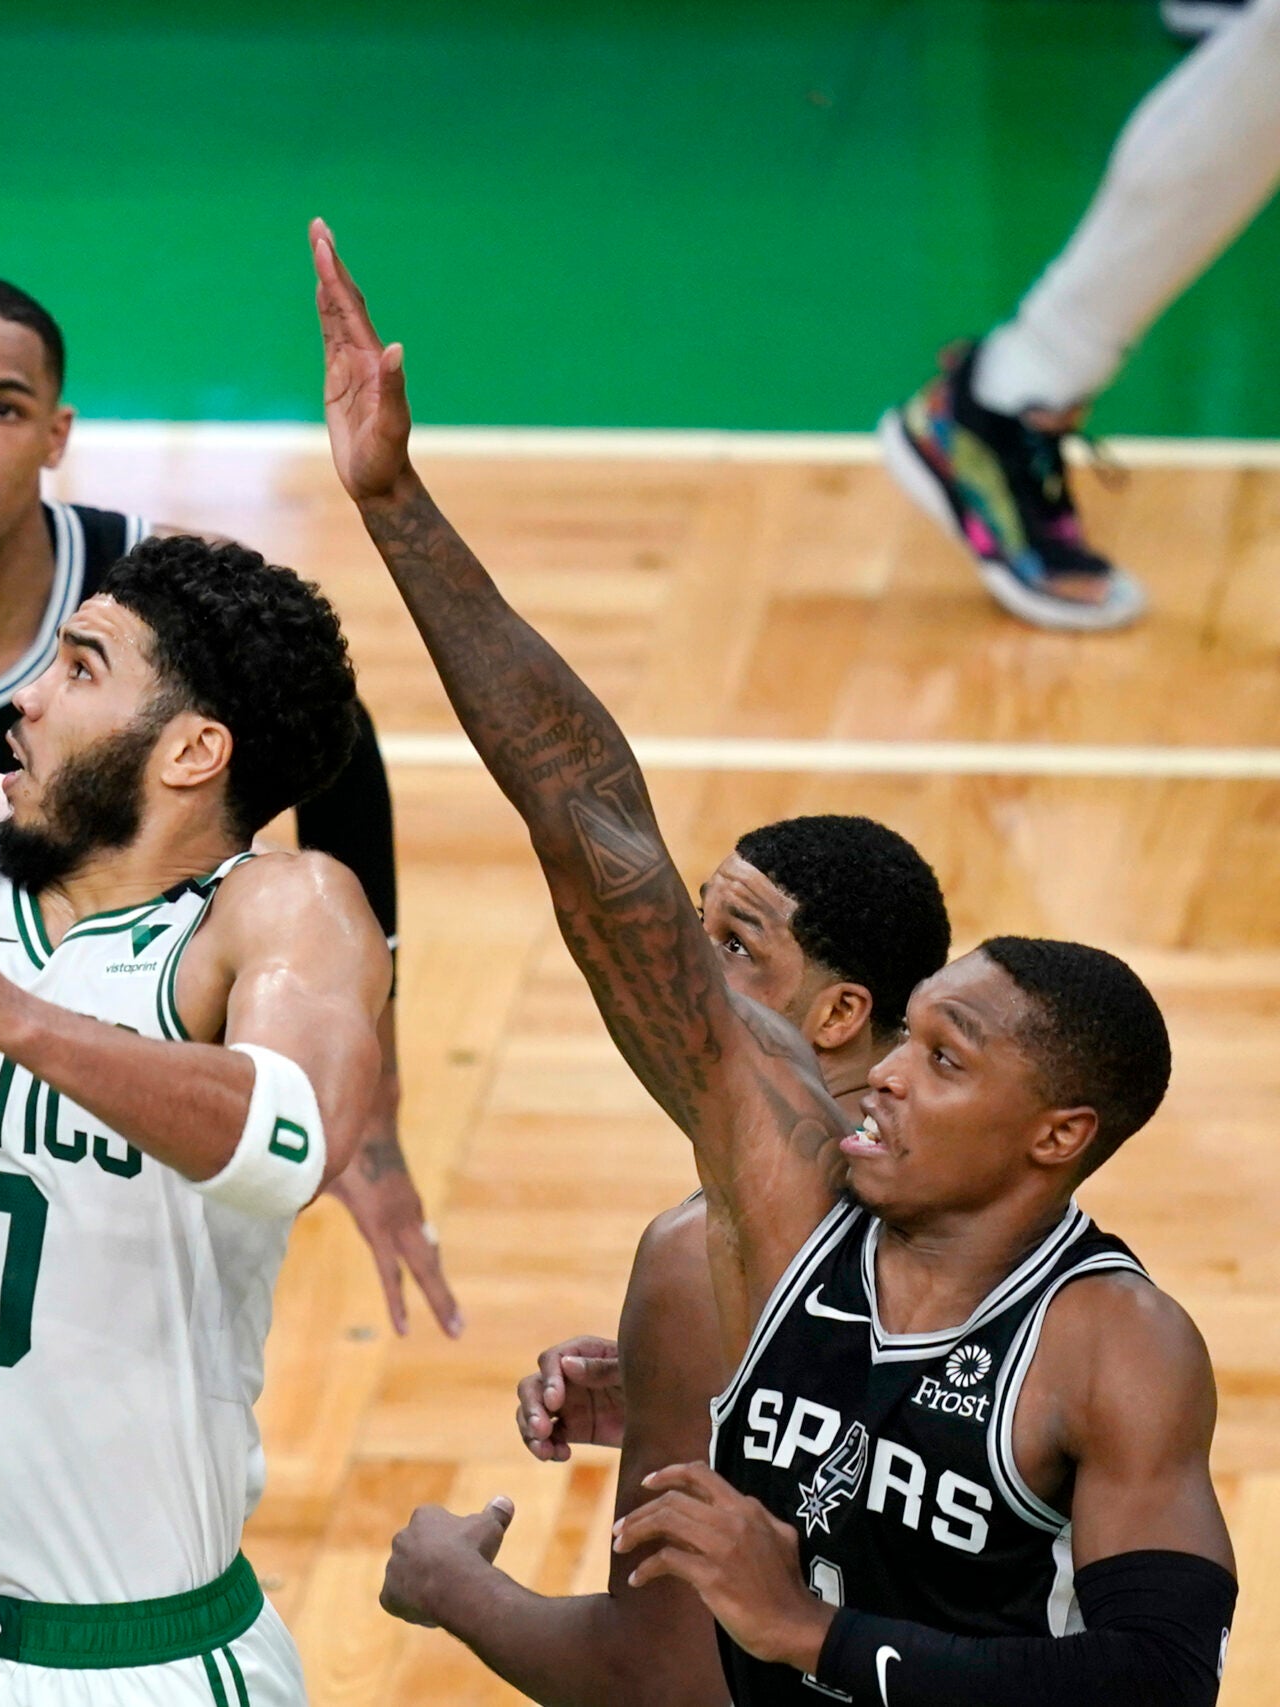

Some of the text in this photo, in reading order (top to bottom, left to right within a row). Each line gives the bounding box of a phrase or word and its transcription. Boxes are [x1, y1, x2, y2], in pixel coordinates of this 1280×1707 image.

[105, 961, 158, 975] vistaprint
[269, 1117, 309, 1163] 0
[911, 1376, 990, 1422] Frost
[743, 1388, 992, 1554] SPURS
